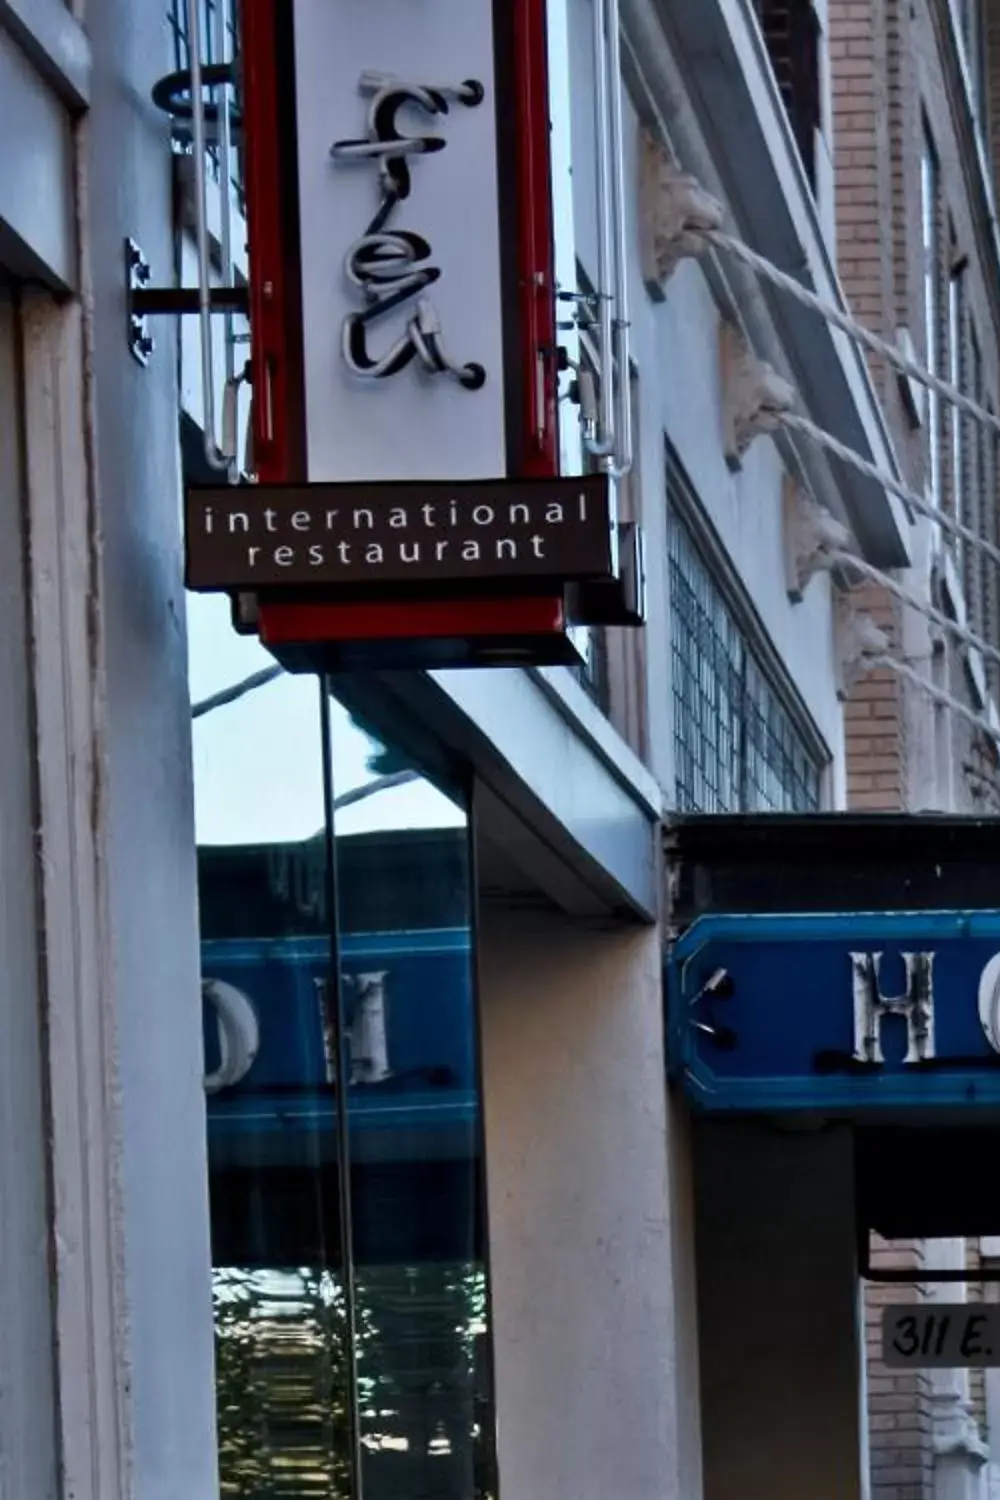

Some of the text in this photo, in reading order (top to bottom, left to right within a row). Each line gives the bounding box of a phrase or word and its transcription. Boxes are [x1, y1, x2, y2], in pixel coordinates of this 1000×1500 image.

[204, 494, 588, 534] international
[248, 534, 546, 567] restaurant
[892, 1314, 949, 1357] 311
[958, 1314, 993, 1358] E.
